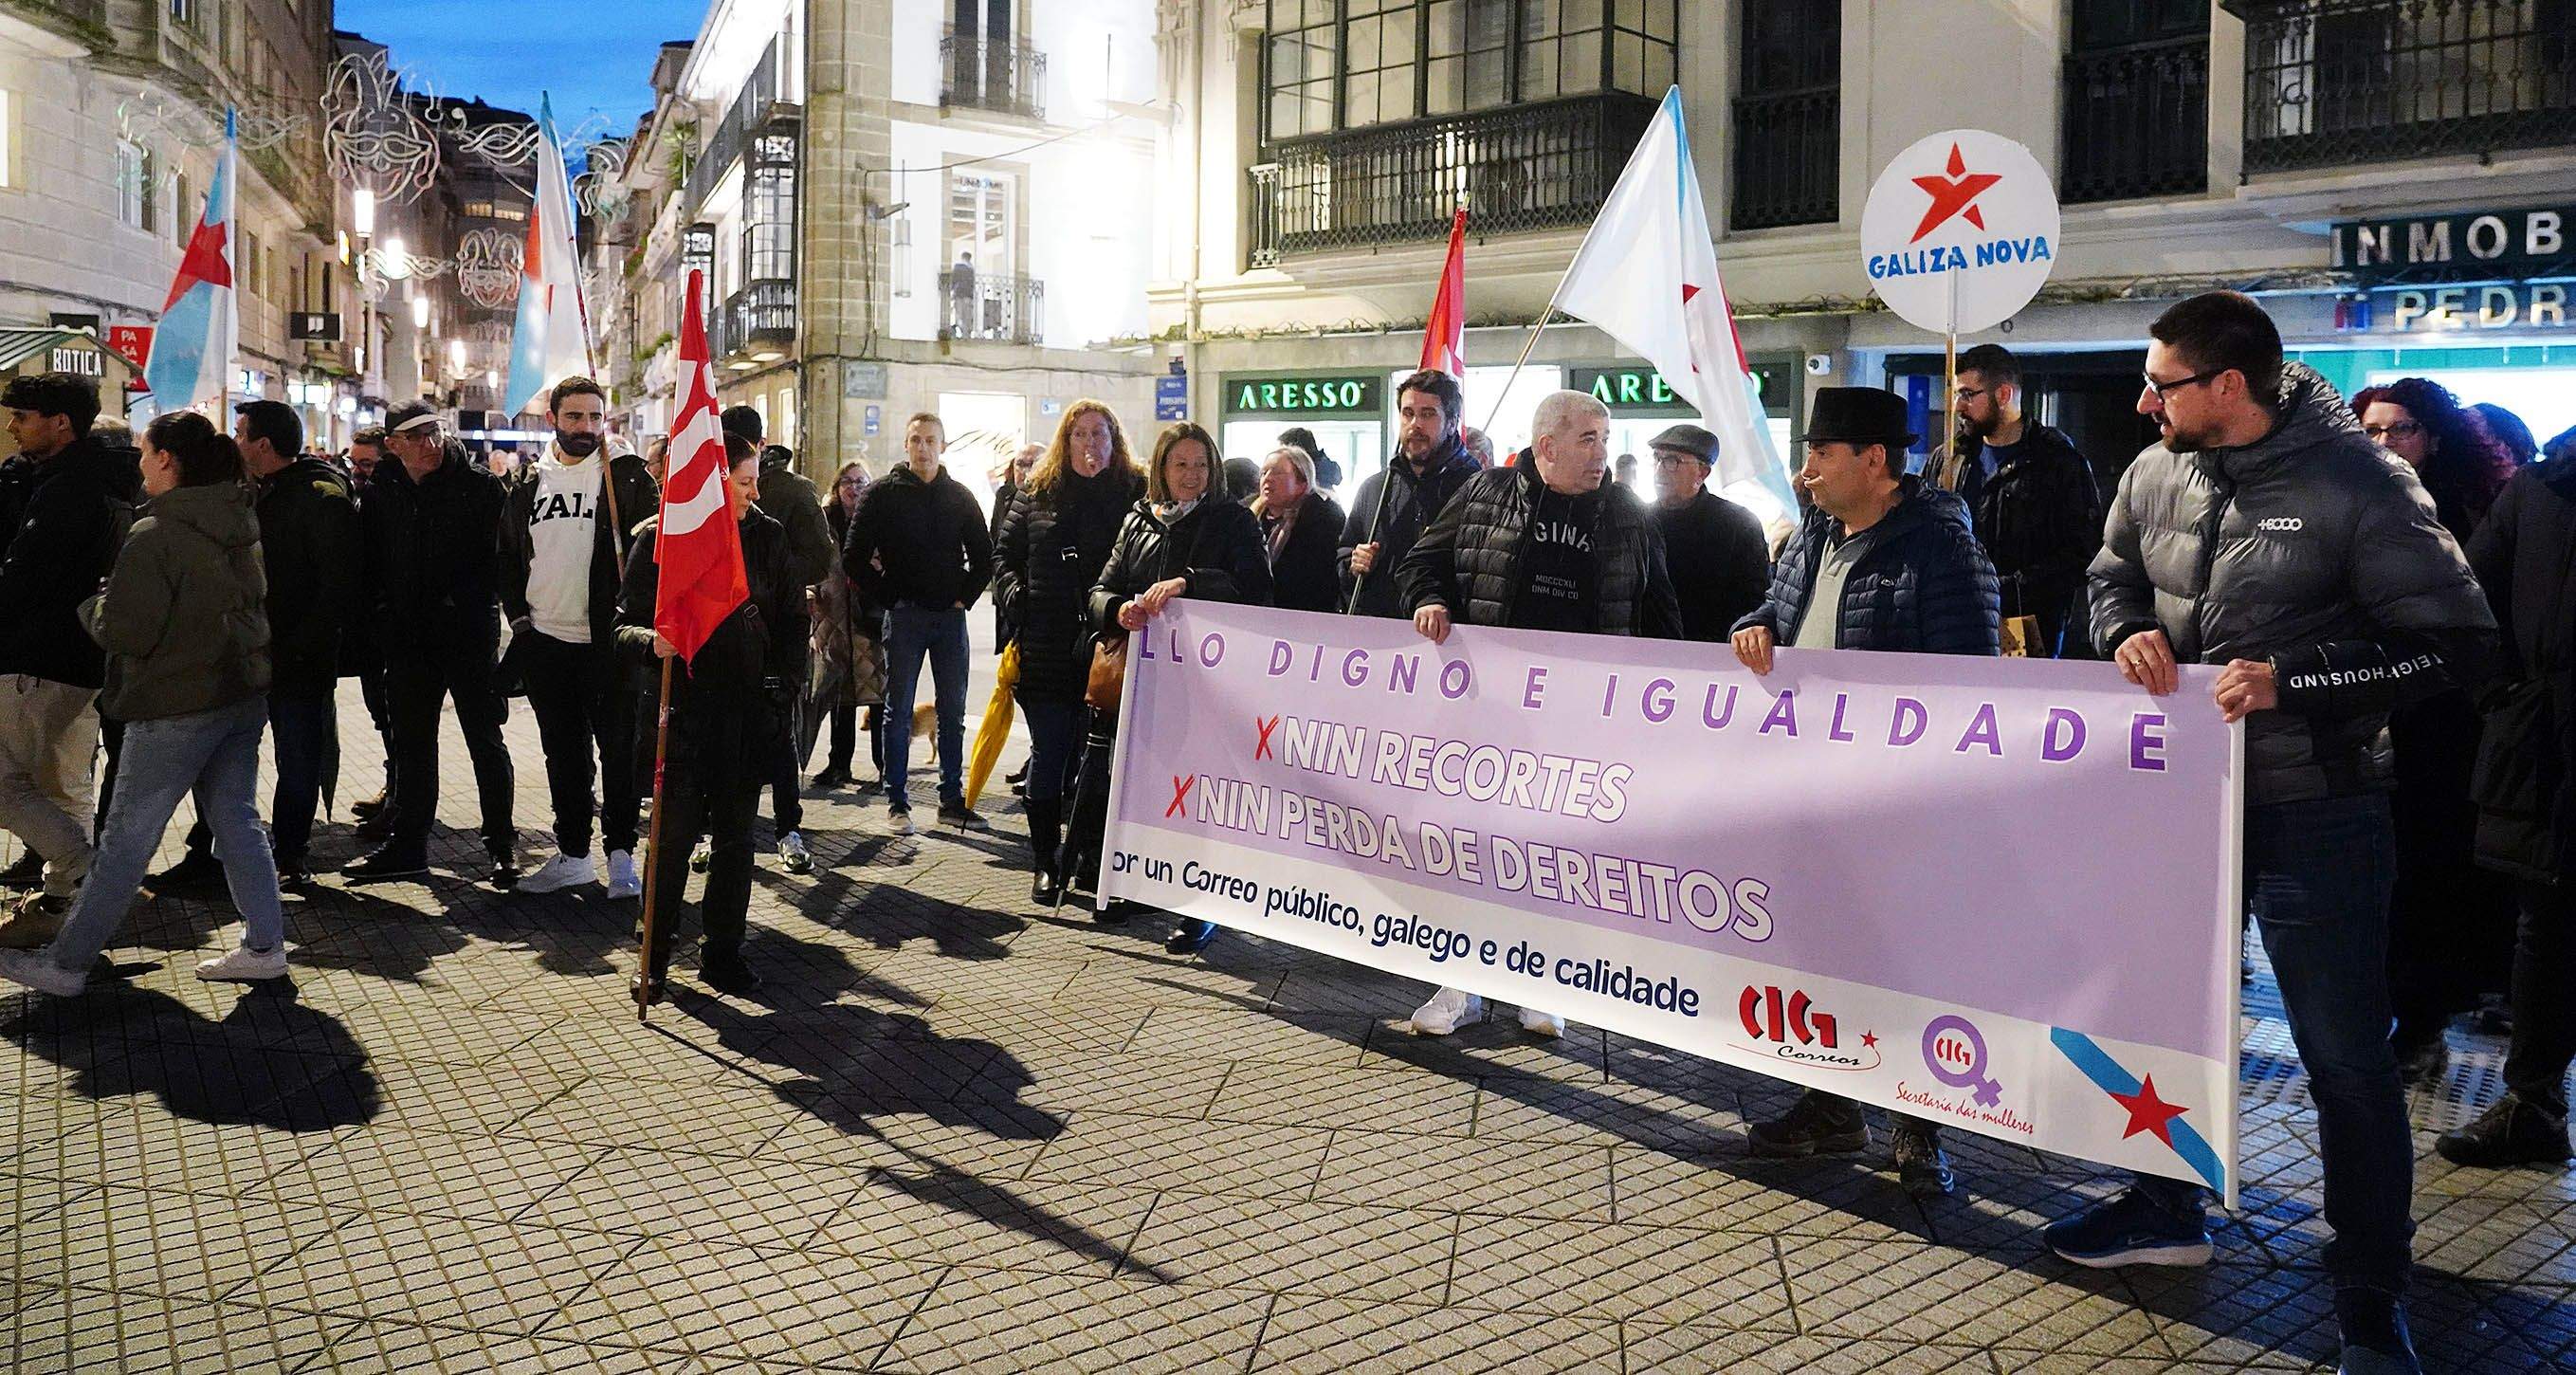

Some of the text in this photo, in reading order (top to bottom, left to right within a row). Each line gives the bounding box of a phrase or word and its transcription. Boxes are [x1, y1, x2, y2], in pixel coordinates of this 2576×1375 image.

[1869, 236, 2051, 279] GALIZA NOVA
[2329, 211, 2563, 267] INMOB
[2395, 285, 2567, 331] PEDR
[121, 330, 137, 341] PA
[53, 348, 101, 376] BOTICA
[1239, 381, 1361, 409] ARESSO
[1141, 625, 2168, 771] LLO DIGNO E IGUALDADE
[1283, 716, 1634, 822] NIN RECORTES
[1197, 775, 1774, 942] NIN PERDA DE DEREITOS
[1144, 857, 1173, 884] un
[1182, 861, 1258, 903] Correo
[1265, 884, 1363, 937] público,
[1371, 913, 1471, 962] galego
[1479, 940, 1496, 965] e
[1506, 941, 1544, 977] de
[1555, 959, 1700, 1017] calidade
[1778, 1045, 1861, 1066] Correos
[1956, 1098, 1977, 1119] das
[1982, 1109, 2033, 1134] mulleres
